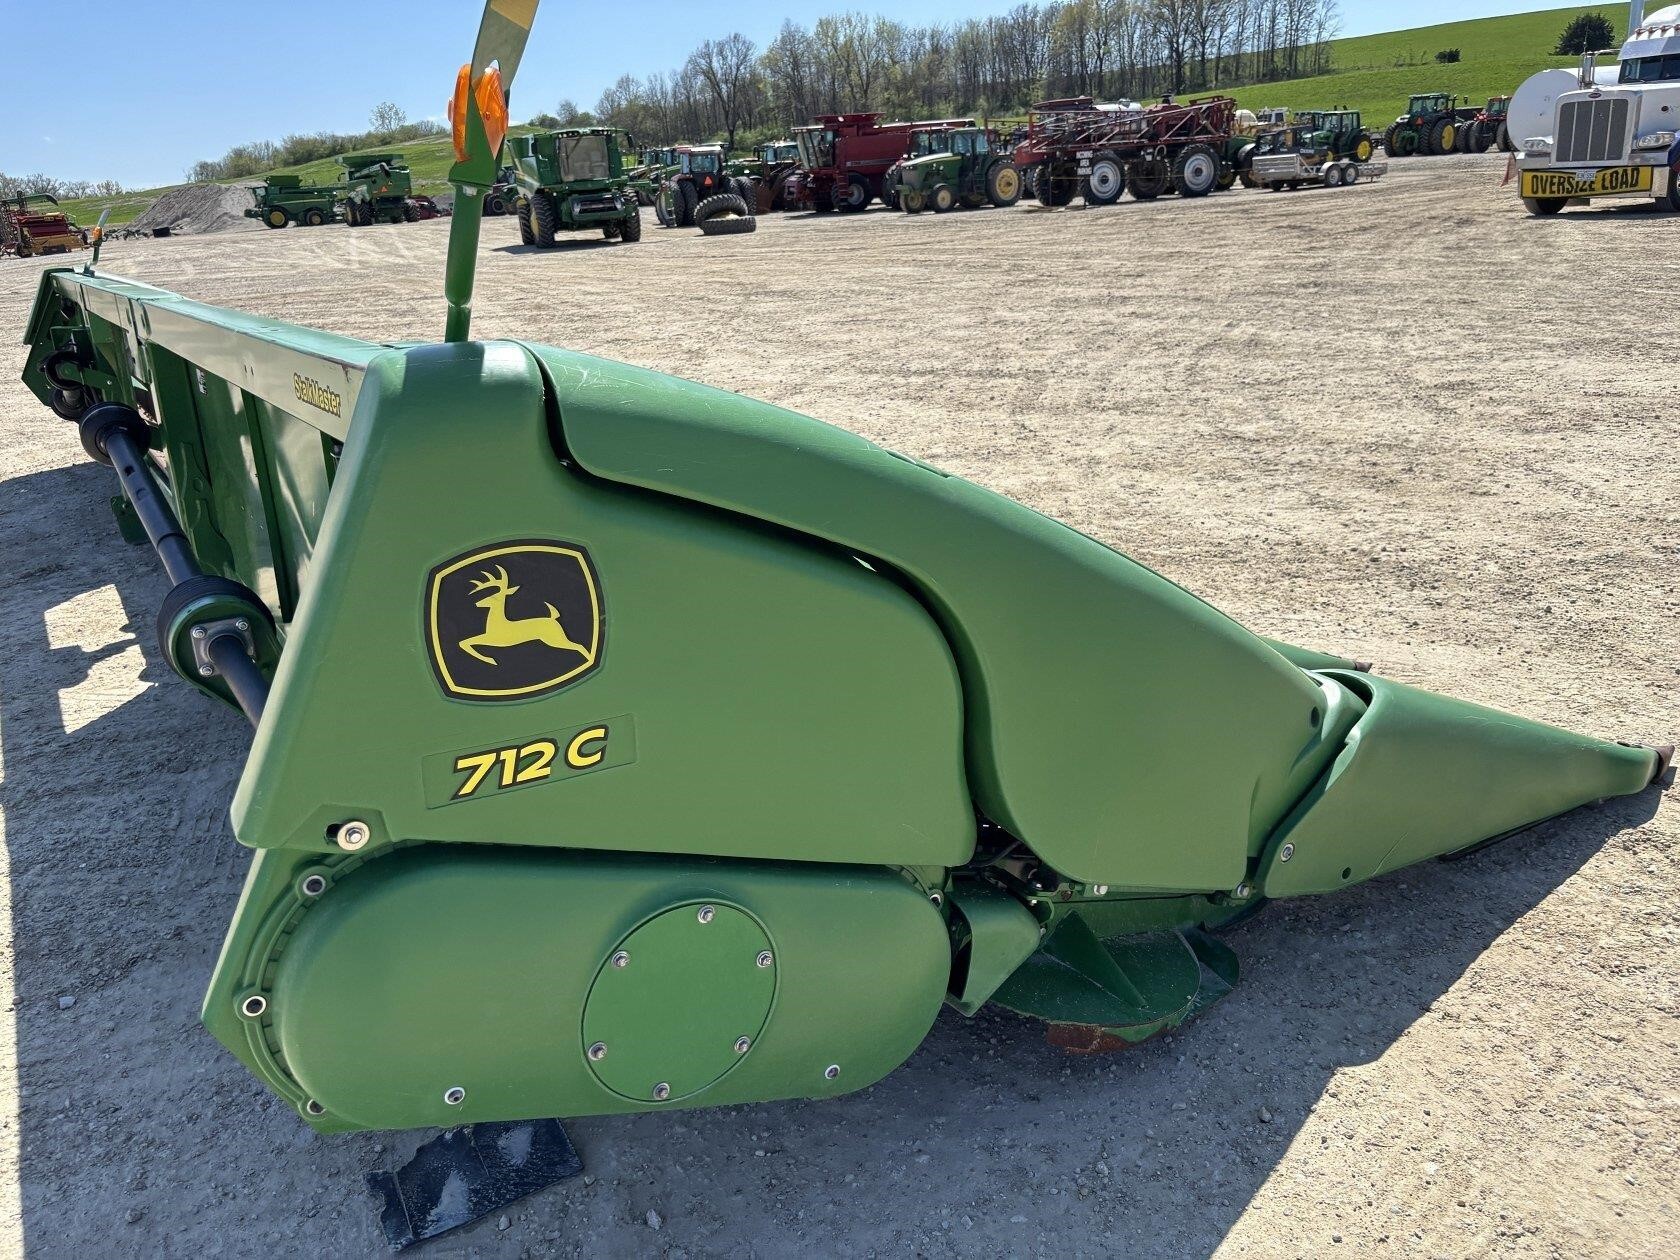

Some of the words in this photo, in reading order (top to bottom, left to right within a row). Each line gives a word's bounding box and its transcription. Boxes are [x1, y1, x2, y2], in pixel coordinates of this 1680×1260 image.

[1531, 174, 1596, 195] OVERSIZE
[1601, 167, 1640, 190] LOAD
[293, 372, 341, 418] StalkMaster
[451, 738, 558, 799] 712
[564, 724, 609, 770] C
